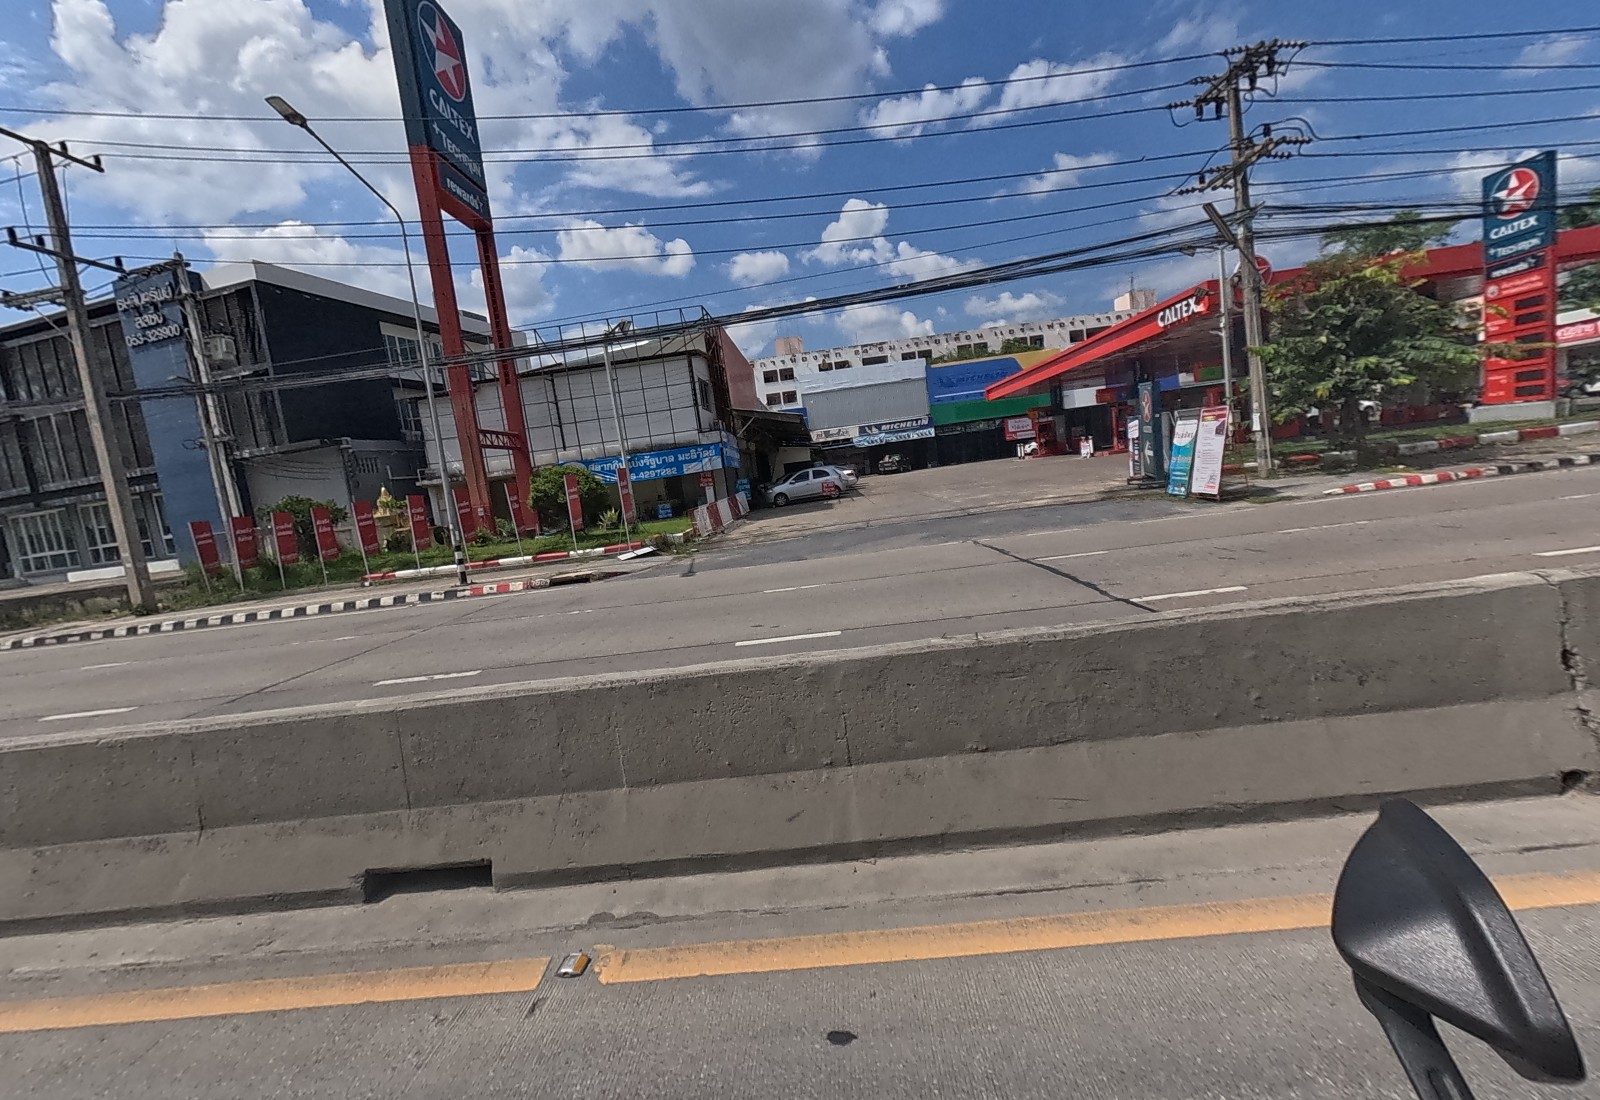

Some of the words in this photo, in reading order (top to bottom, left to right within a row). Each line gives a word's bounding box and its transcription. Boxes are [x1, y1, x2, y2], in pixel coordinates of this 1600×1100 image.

[429, 88, 475, 145] CALTEX
[1489, 215, 1538, 240] CALTEX
[1157, 295, 1198, 328] CALTEX
[881, 416, 929, 431] MICHELIN
